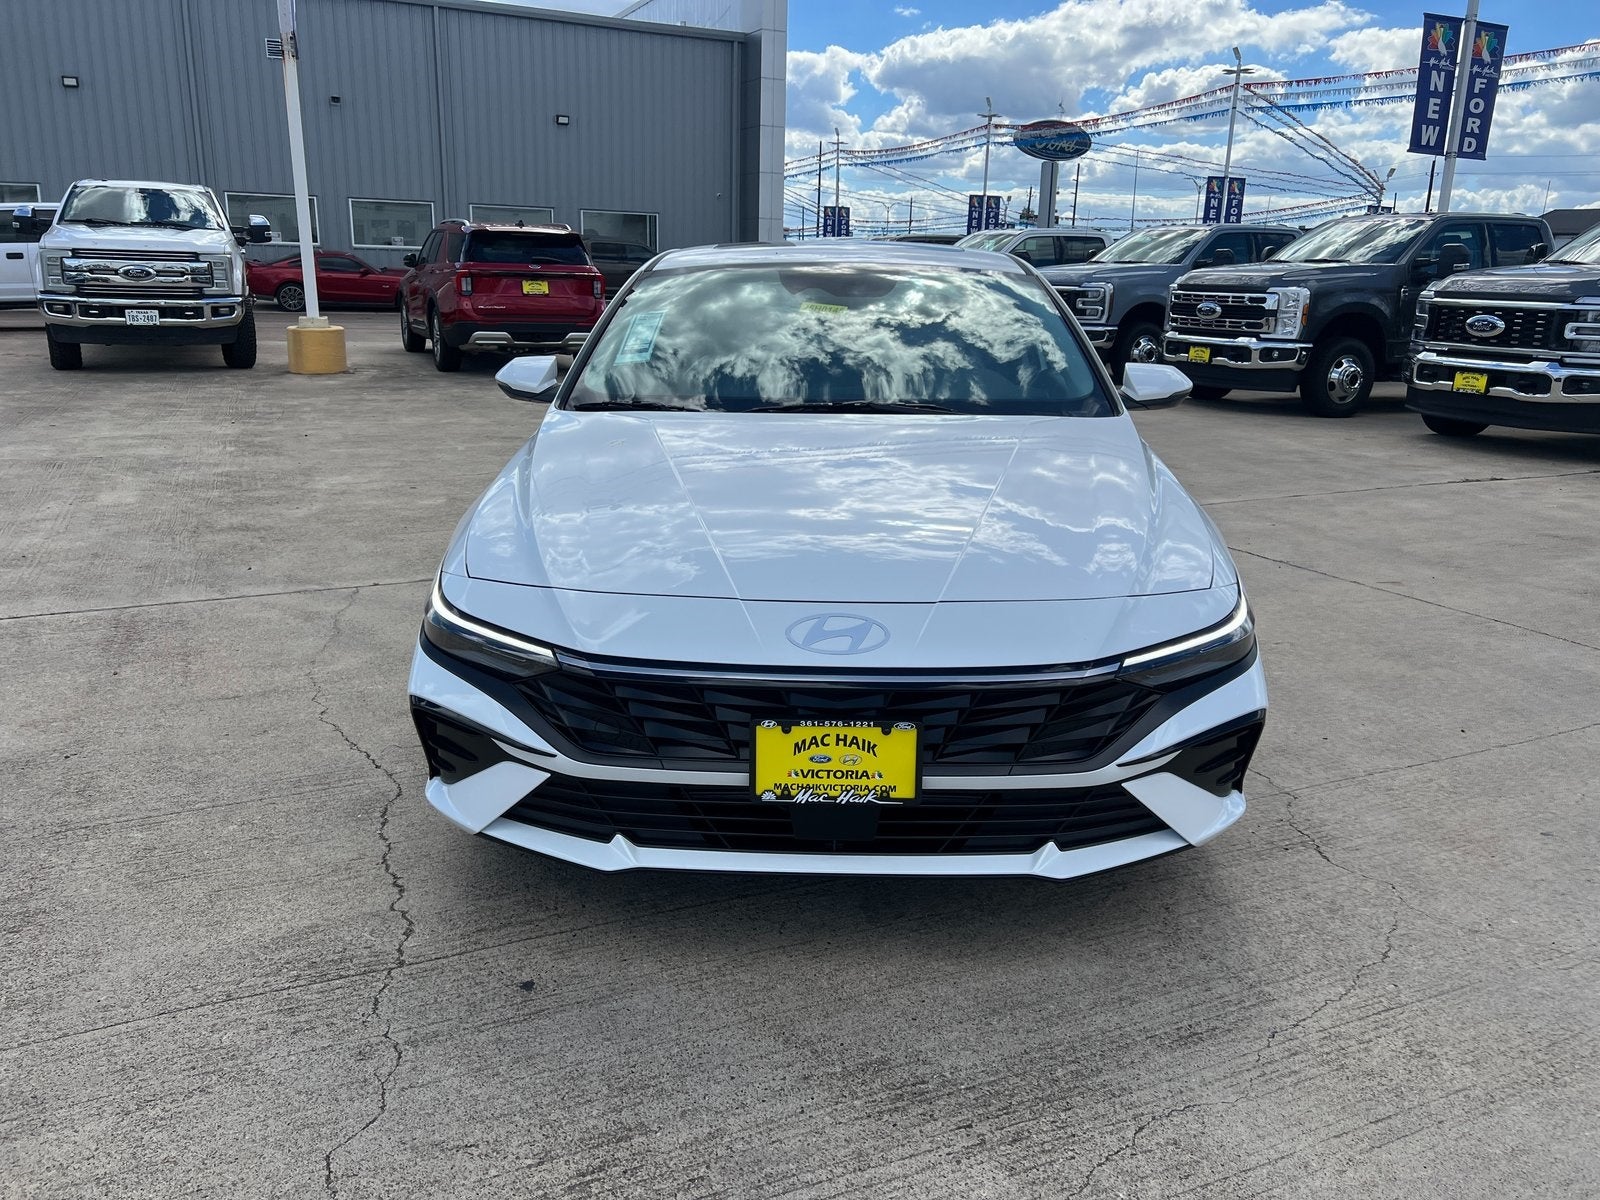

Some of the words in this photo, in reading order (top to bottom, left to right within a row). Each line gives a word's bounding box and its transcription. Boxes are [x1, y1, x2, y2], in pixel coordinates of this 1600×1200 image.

[1420, 70, 1446, 147] NEW
[1462, 77, 1488, 153] FORD
[1229, 199, 1239, 223] FOR
[799, 720, 875, 728] 361-576-1221
[792, 733, 831, 757] MAC
[835, 733, 879, 758] HAIK
[811, 755, 830, 763] Ford
[799, 768, 871, 780] VICTORIA
[773, 782, 897, 793] MACHAIKVICTORIACOM
[792, 788, 829, 804] Mac
[835, 789, 880, 805] Haik
